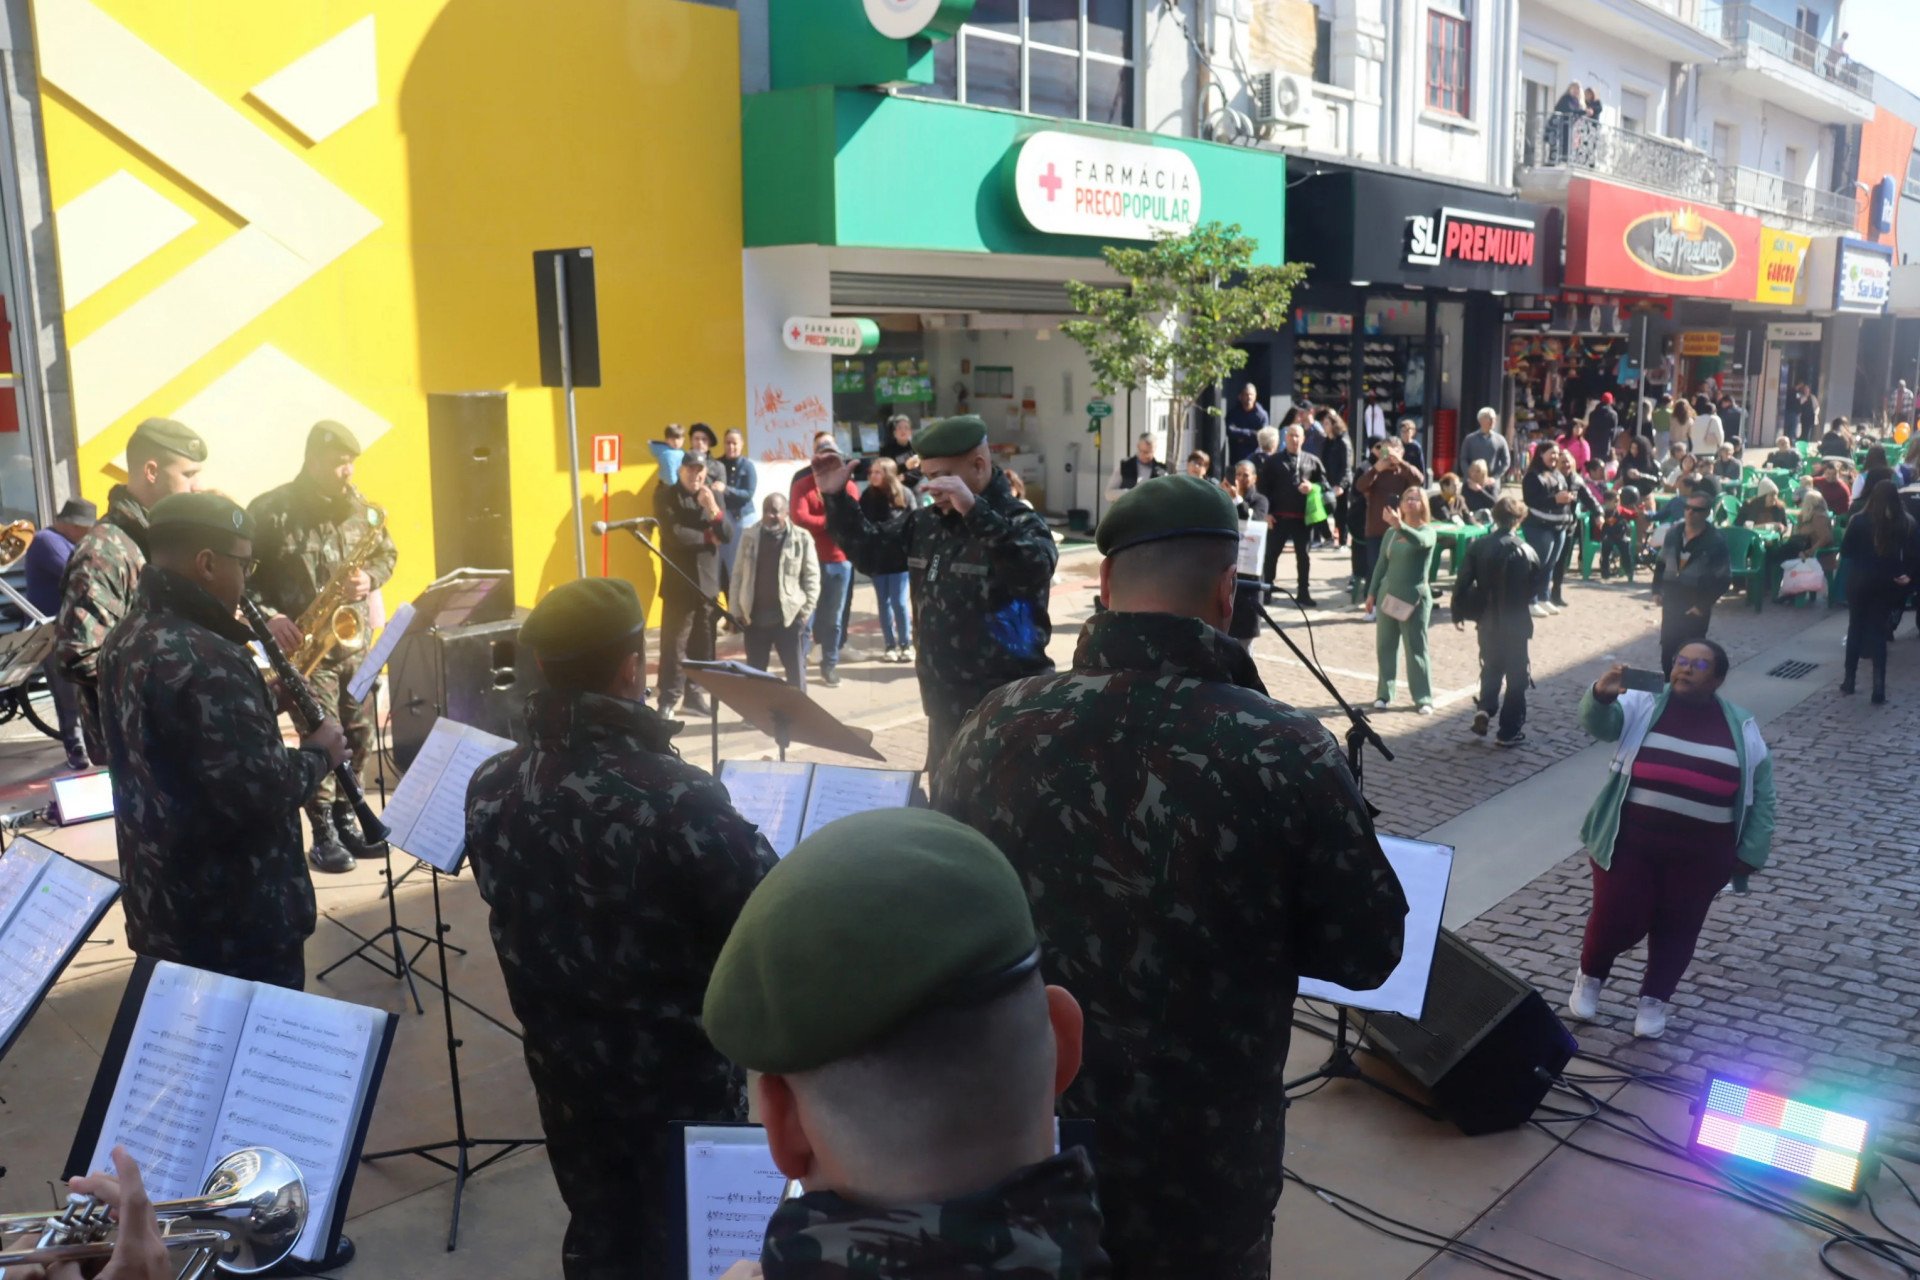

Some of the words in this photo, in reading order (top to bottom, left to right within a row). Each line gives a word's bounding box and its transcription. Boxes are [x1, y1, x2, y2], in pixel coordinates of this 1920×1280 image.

[1075, 160, 1190, 191] FARMÁCIA
[1407, 215, 1437, 255] SL
[1445, 221, 1535, 266] PREMIUM
